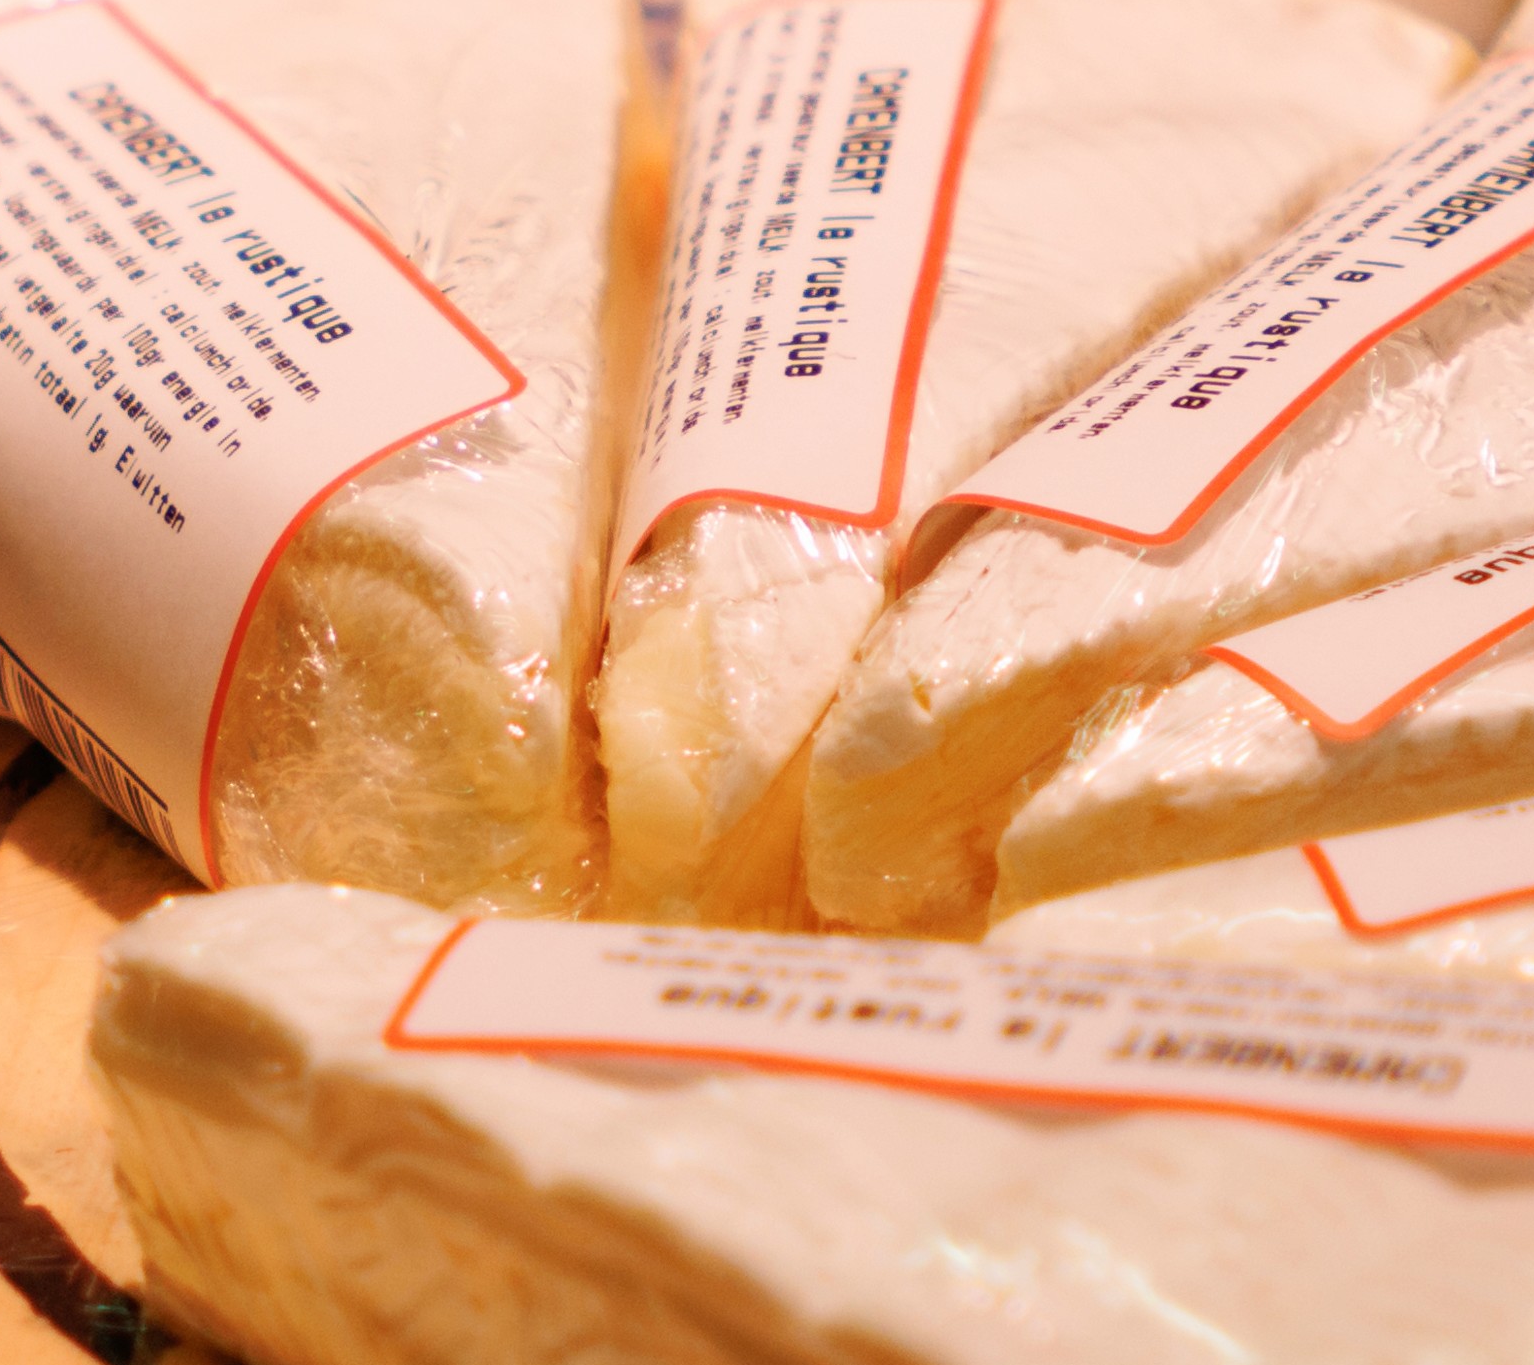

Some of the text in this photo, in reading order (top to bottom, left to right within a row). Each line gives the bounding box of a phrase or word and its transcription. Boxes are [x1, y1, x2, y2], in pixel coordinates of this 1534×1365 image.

[222, 229, 354, 344] rustique
[778, 256, 849, 378] rustique
[1170, 296, 1340, 411] rustique
